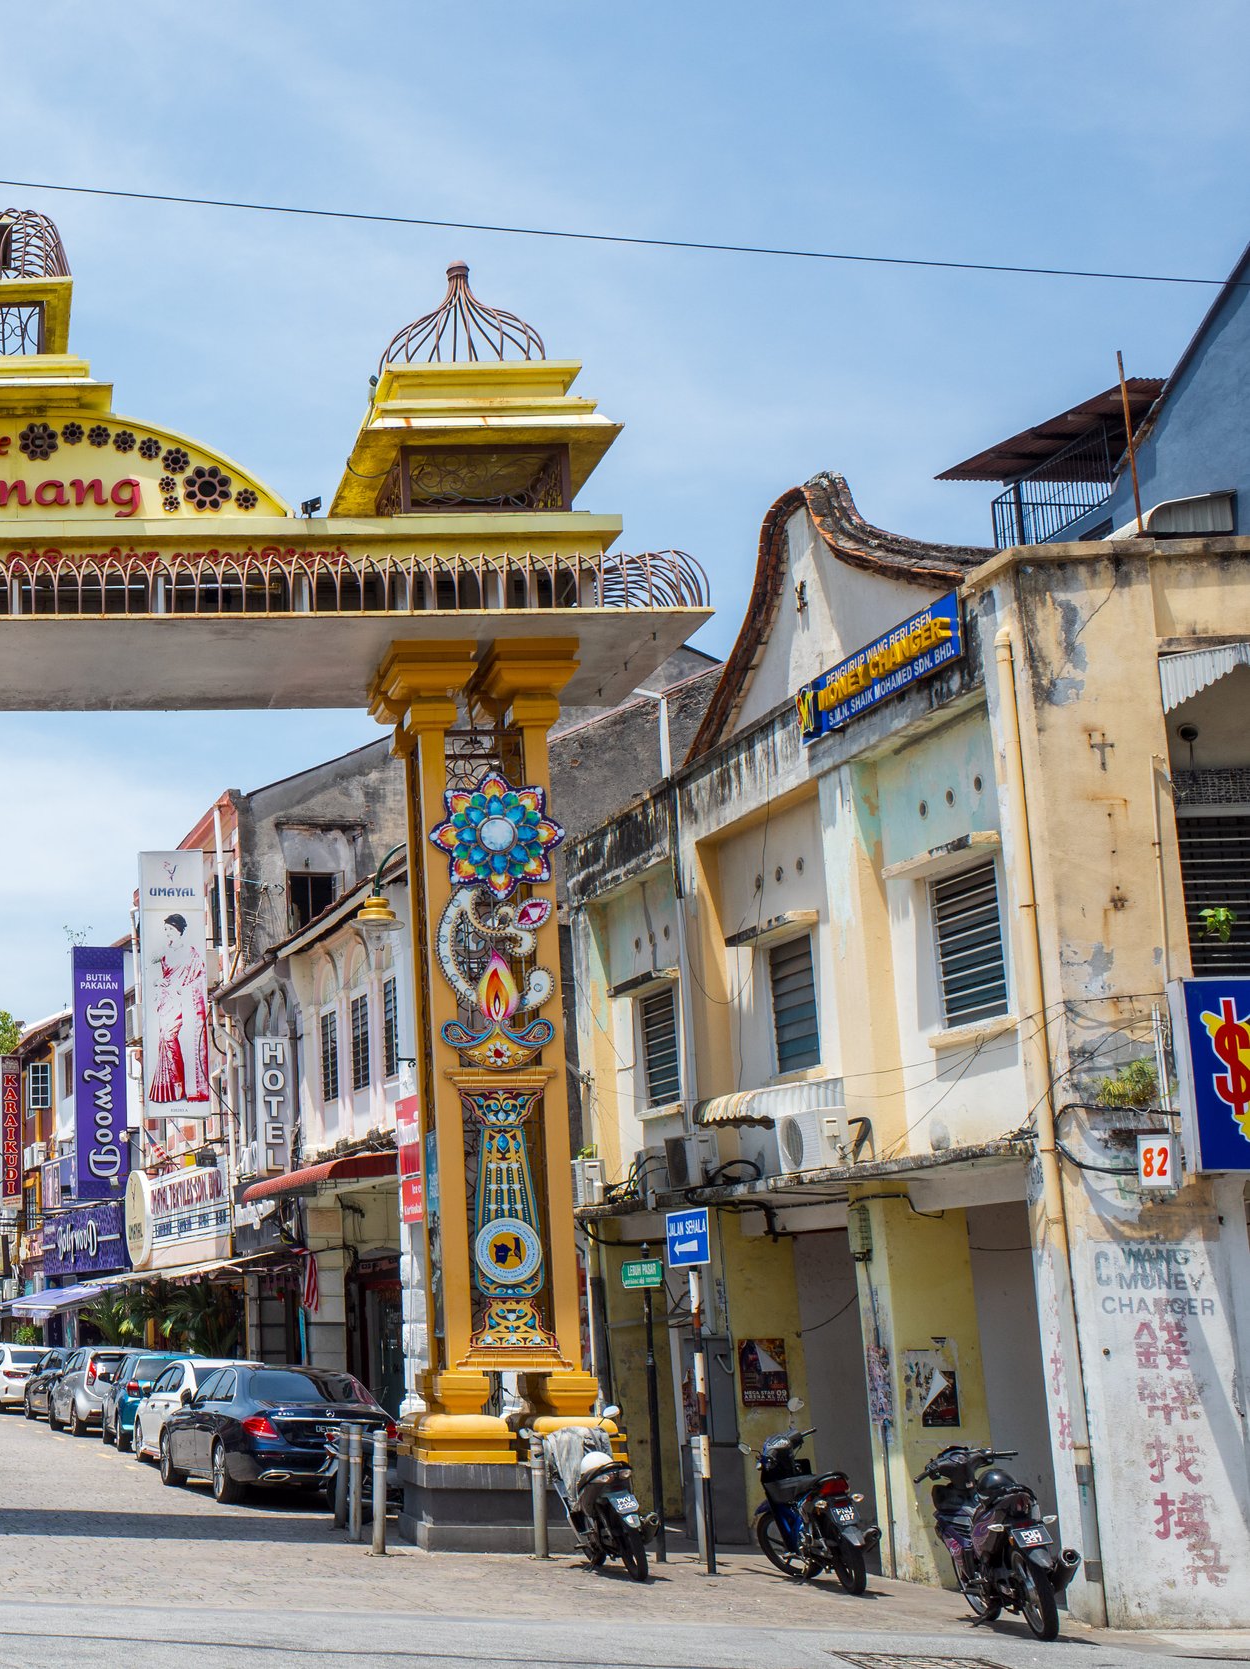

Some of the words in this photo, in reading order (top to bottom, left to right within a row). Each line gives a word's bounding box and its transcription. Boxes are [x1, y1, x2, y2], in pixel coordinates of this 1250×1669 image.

[826, 653, 865, 687] PENGURUP
[865, 638, 888, 663] WANG
[889, 611, 932, 648] BERLESEN
[818, 664, 871, 711] MONEY
[869, 617, 951, 679] CHANGER
[828, 703, 850, 726] S.M.N.
[850, 687, 873, 713] SHAIK
[874, 665, 912, 700] MOHAMED
[913, 654, 933, 676] SDN.
[934, 642, 955, 665] BHD.
[149, 887, 196, 897] UMAYAL
[80, 982, 118, 990] PAKAIAN
[86, 973, 112, 982] BUTIK
[263, 1042, 285, 1171] HOTEL
[3, 1074, 18, 1194] KARAIKUDI
[1142, 1147, 1169, 1177] 82
[669, 1221, 684, 1237] JALAN
[685, 1218, 707, 1235] SEHALA
[1121, 1248, 1190, 1265] WANG
[627, 1264, 642, 1276] LEBUH
[641, 1263, 657, 1275] PASAR
[1119, 1272, 1204, 1290] MONEY
[1101, 1296, 1215, 1316] CHANGER
